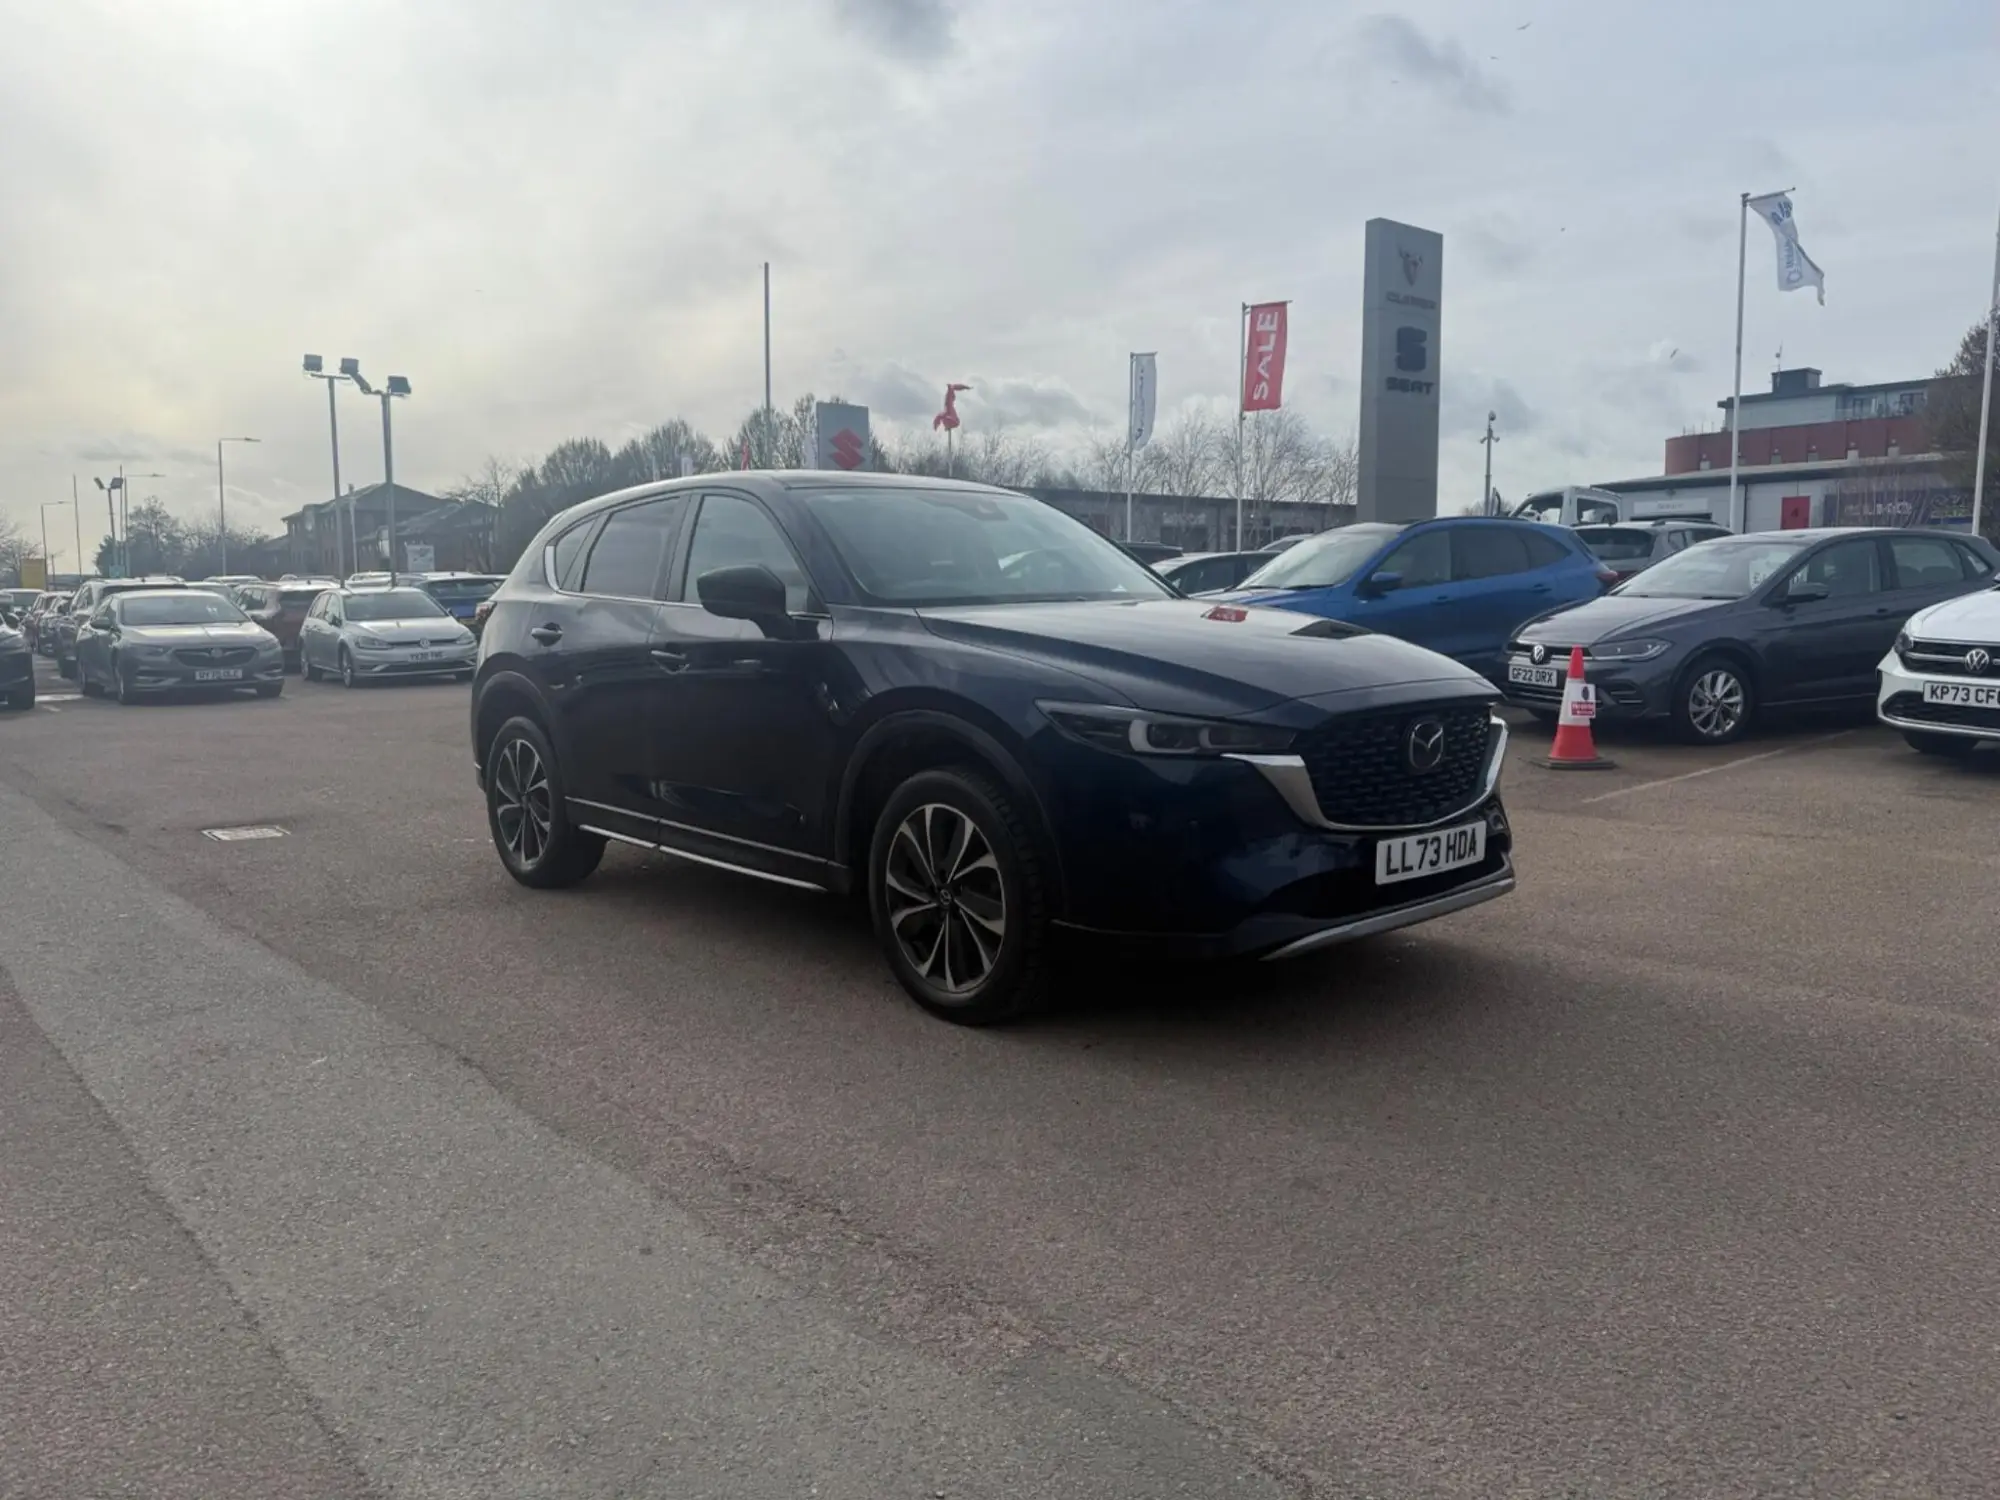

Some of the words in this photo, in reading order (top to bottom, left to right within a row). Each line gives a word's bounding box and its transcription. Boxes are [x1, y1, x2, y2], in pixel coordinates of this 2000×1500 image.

[1252, 311, 1279, 401] SALE
[1512, 667, 1533, 682] GF22
[1535, 670, 1553, 685] DRX
[1930, 684, 1970, 702] KP73
[1386, 836, 1440, 876] LL73
[1445, 827, 1476, 863] HDA
